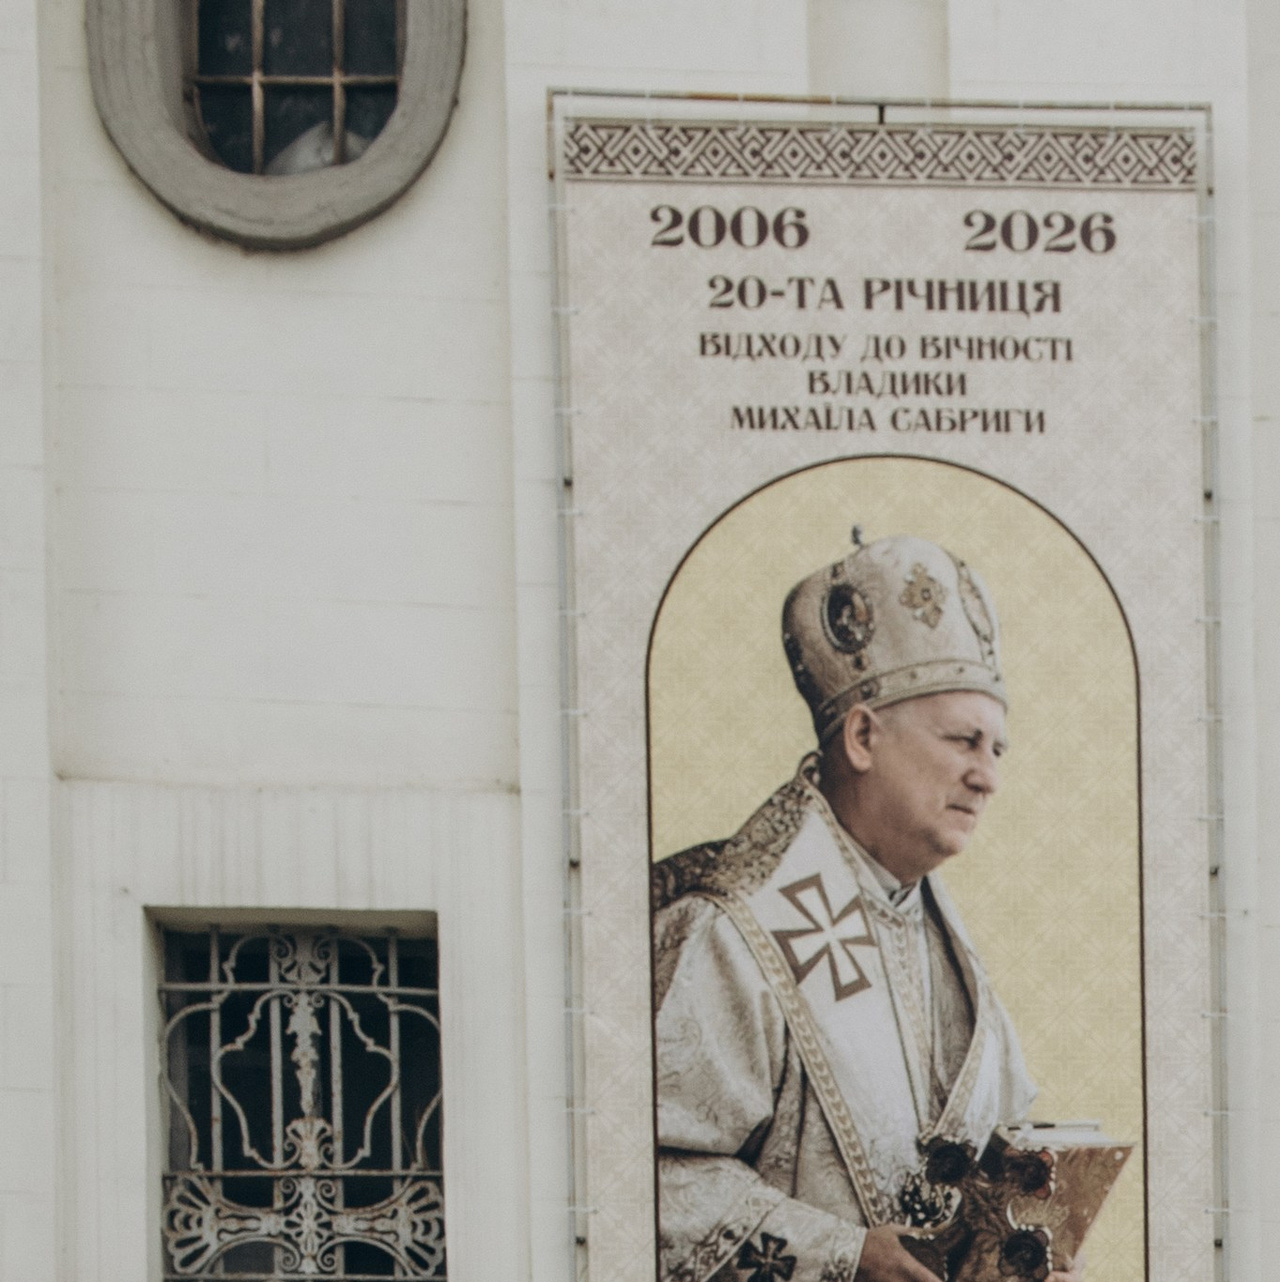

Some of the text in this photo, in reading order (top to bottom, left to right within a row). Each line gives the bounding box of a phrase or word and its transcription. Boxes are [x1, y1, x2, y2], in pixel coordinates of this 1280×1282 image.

[649, 205, 810, 249] 2006
[963, 211, 1117, 254] 2026
[708, 275, 1061, 317] 20-ТА РІЧНИЦЯ
[699, 332, 1073, 363] ВІДХОДУ ДО ВІЧНОСТІ
[808, 370, 967, 399] ВЛАДИКИ
[732, 403, 1045, 434] МИХАЇЛА САБРИГИ
